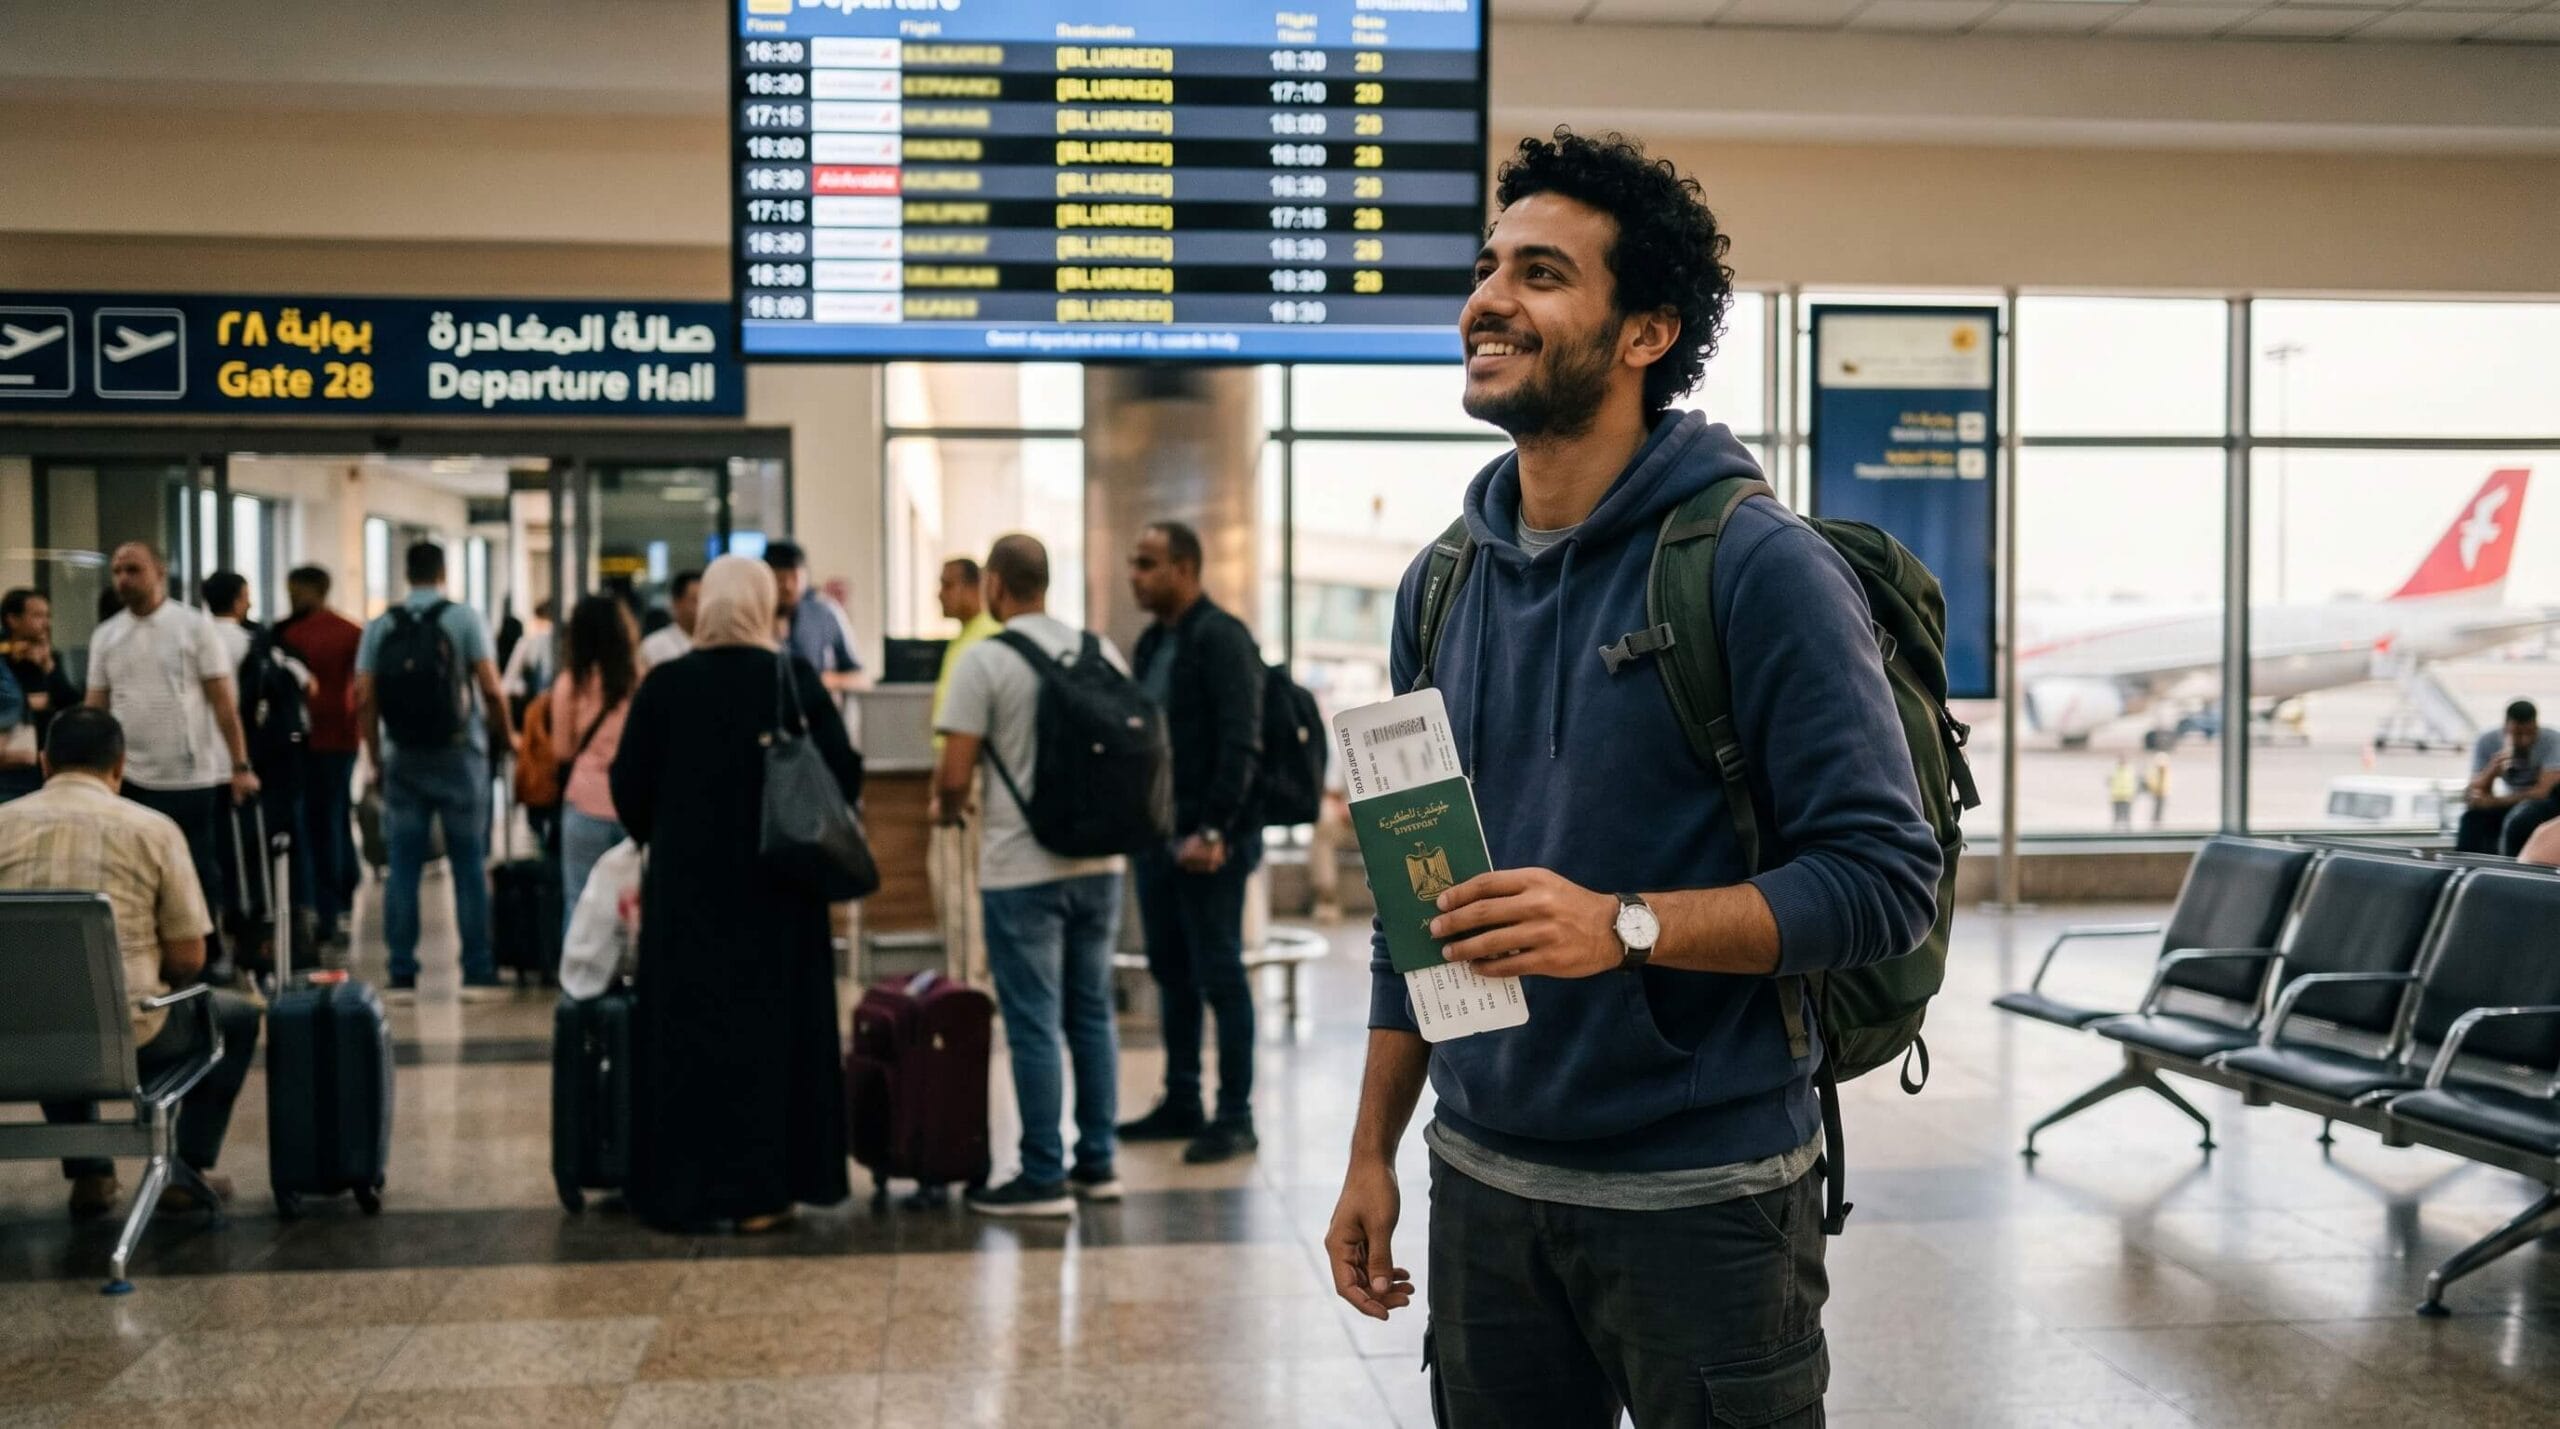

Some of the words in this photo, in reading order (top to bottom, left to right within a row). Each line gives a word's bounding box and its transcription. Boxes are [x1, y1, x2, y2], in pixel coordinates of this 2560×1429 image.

[747, 105, 804, 126] 17:15
[748, 200, 805, 221] 17:15
[218, 311, 268, 346] ٢٨
[277, 308, 372, 354] بوابة
[428, 311, 604, 357] المغادرة
[612, 311, 715, 353] صالة
[218, 361, 313, 398] Gate
[324, 361, 374, 398] 28
[428, 362, 629, 408] Departure
[638, 362, 715, 401] Hall
